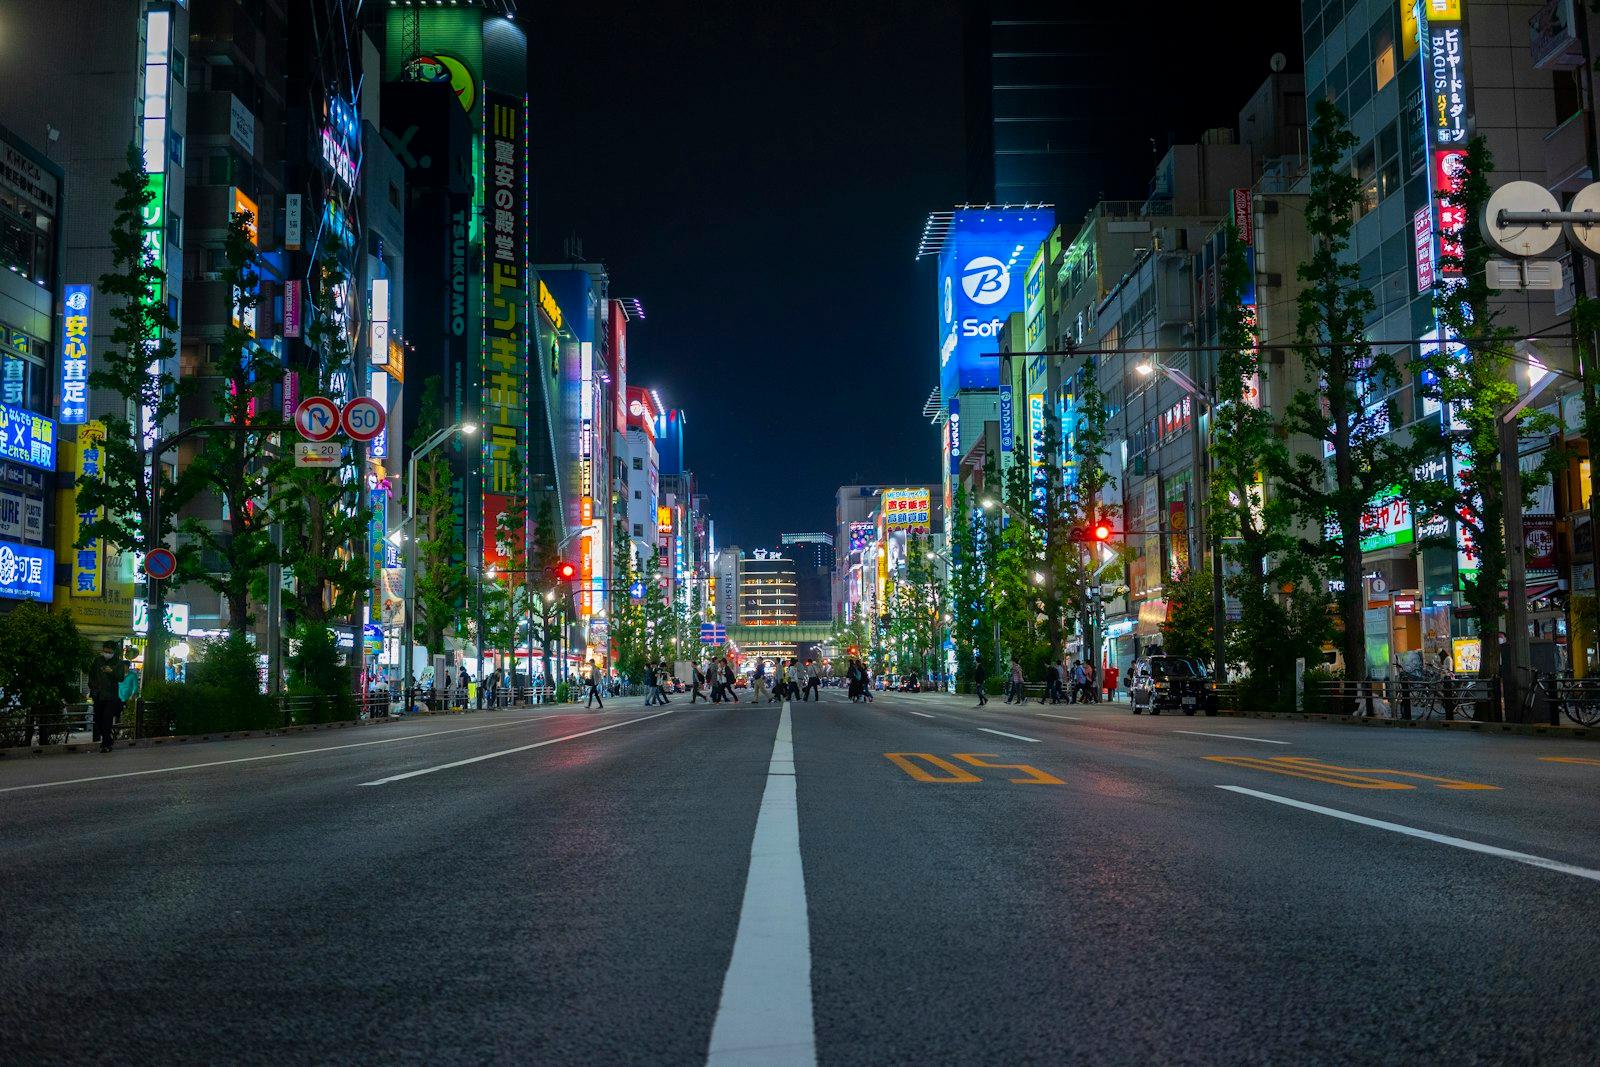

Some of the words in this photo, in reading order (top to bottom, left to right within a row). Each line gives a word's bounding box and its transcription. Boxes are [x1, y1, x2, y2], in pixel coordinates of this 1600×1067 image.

[1437, 94, 1448, 127] バグース
[452, 209, 465, 337] TSUKUMO
[64, 315, 88, 402] 安心査定
[9, 408, 31, 426] なんでも
[31, 416, 52, 444] 高価
[352, 409, 376, 428] 50
[1002, 402, 1011, 435] ソフマップ
[8, 444, 30, 462] どれでも
[30, 440, 52, 468] 買取
[887, 500, 929, 511] 激安販売
[887, 512, 929, 524] 高額買取
[1393, 499, 1407, 526] 2F
